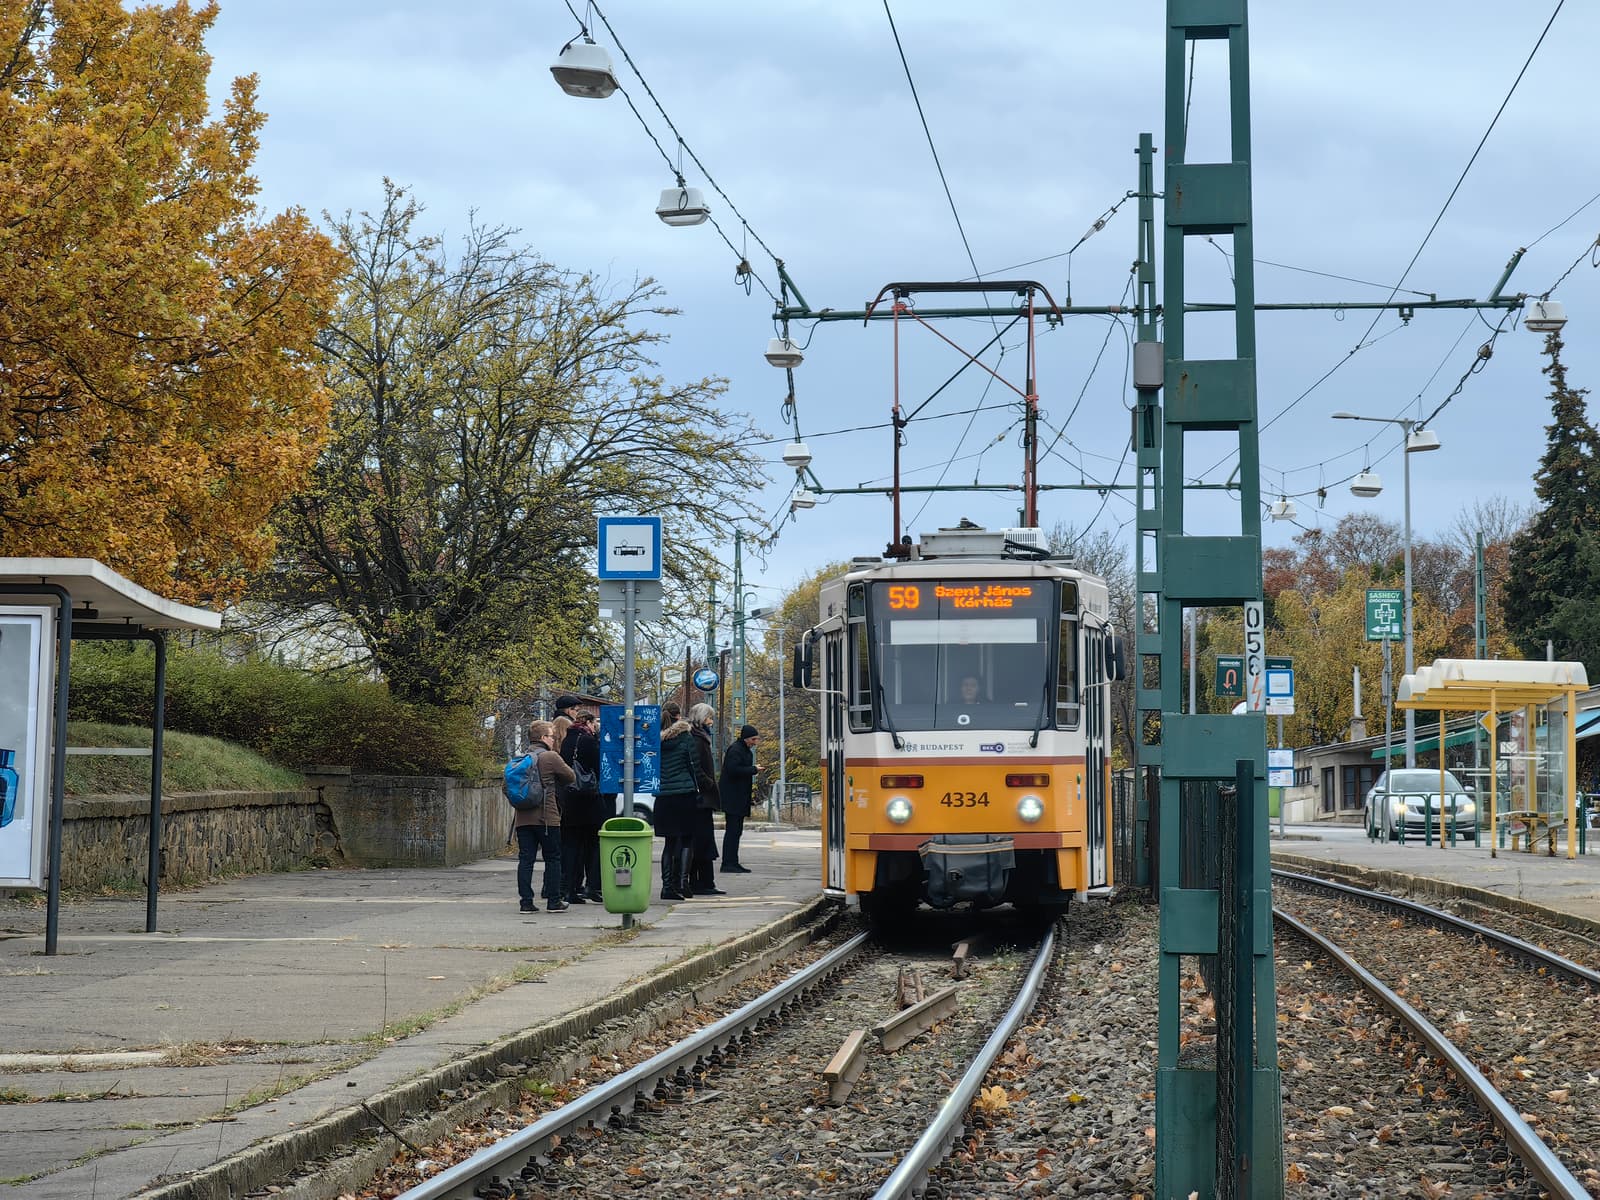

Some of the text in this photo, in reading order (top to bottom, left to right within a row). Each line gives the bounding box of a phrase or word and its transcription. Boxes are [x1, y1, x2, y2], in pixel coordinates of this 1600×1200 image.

[888, 584, 1032, 609] 59 Szent János
[920, 743, 965, 751] BUDAPEST
[940, 791, 990, 808] 4334
